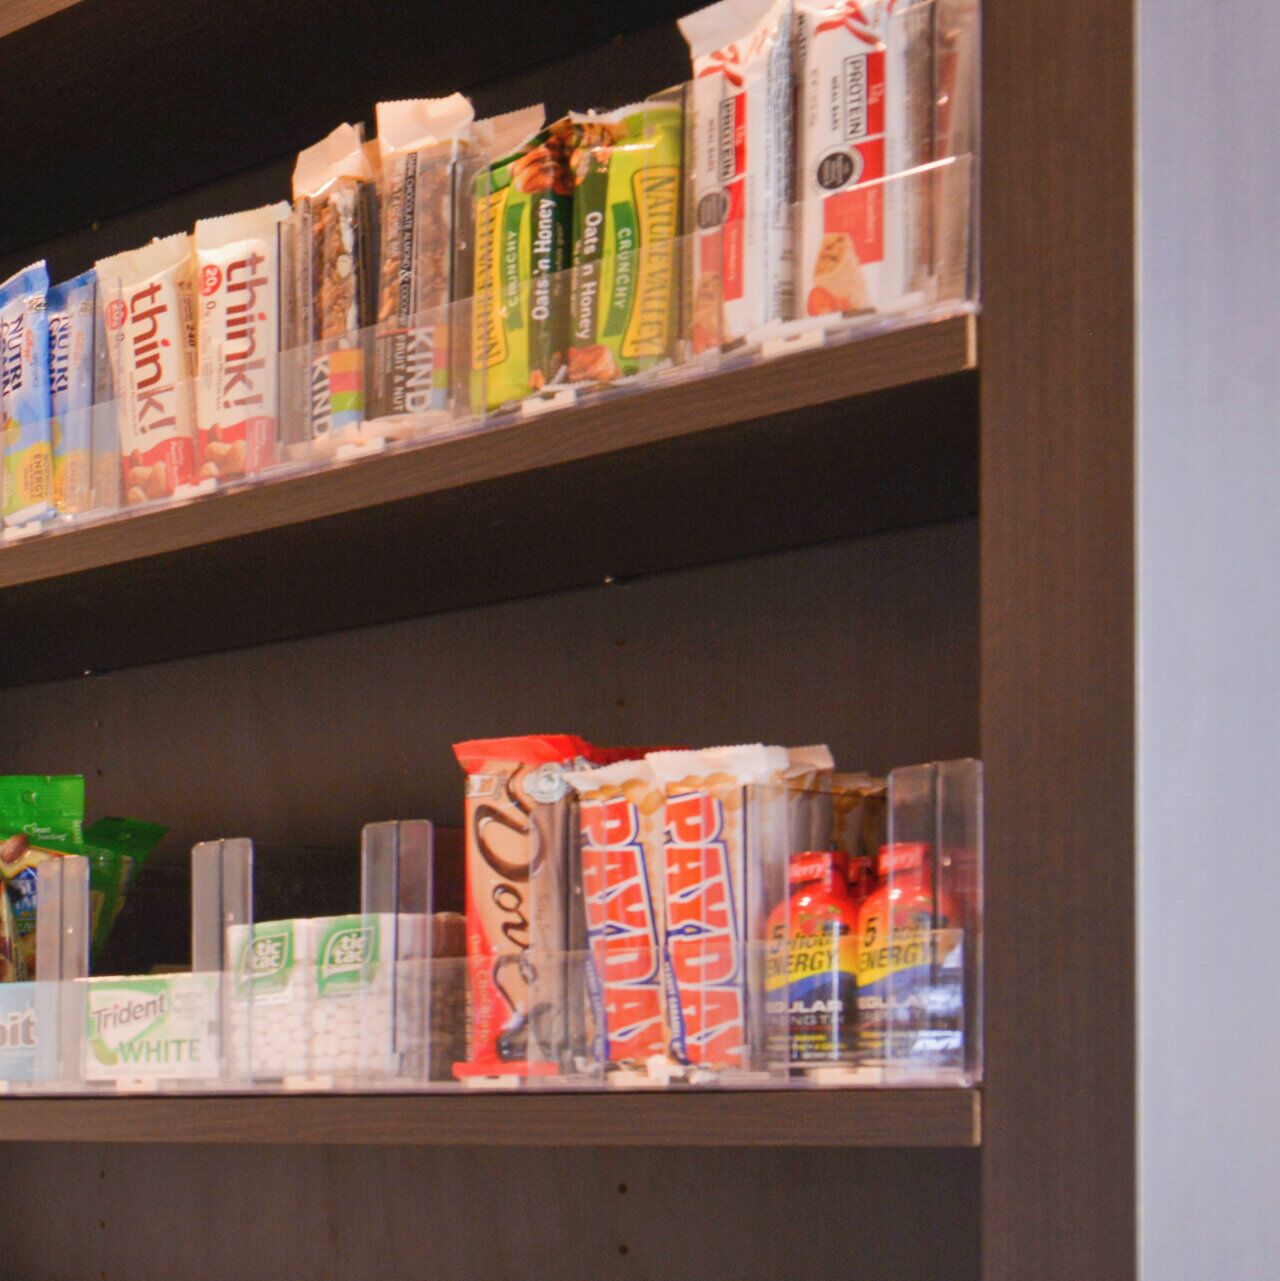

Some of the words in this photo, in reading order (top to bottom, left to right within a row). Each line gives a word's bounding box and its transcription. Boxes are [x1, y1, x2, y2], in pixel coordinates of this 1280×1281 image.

[848, 58, 864, 136] PROTEIN
[536, 198, 557, 245] Honey
[584, 210, 603, 256] Oats
[615, 226, 632, 309] CRUNCHY
[531, 276, 551, 321] Oats
[574, 280, 599, 340] Honey
[223, 251, 269, 411] think!
[129, 281, 178, 436] think!
[406, 326, 435, 414] KIND
[312, 354, 332, 439] KIND
[252, 953, 280, 969] tac
[255, 938, 280, 955] tic
[333, 946, 367, 964] tac
[339, 931, 367, 950] tic
[90, 993, 168, 1035] Trident
[119, 1038, 202, 1064] WHITE
